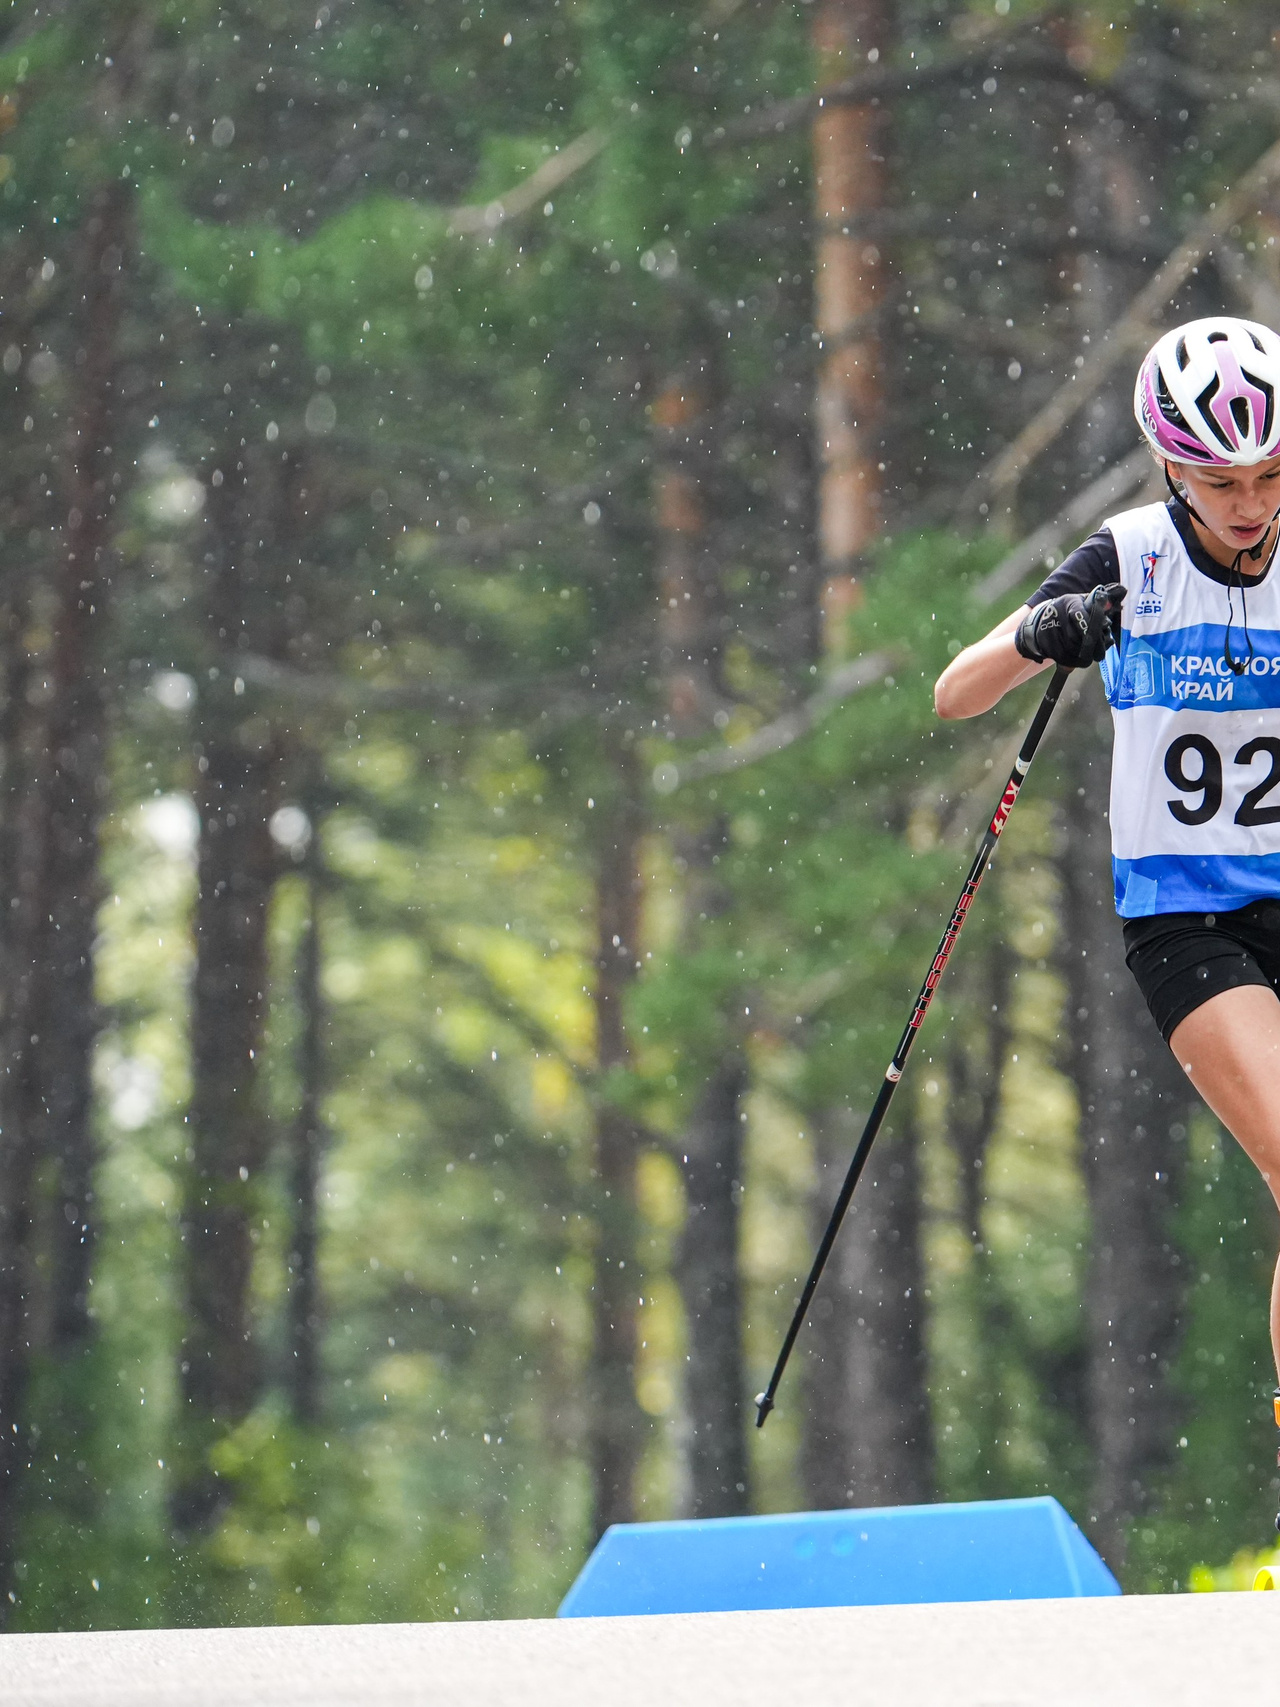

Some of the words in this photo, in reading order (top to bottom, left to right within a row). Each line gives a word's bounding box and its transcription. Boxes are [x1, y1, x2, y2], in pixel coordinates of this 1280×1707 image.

[1136, 605, 1161, 614] СБР
[1171, 677, 1234, 701] КРАЙ
[910, 875, 983, 1028] TEMPESTA
